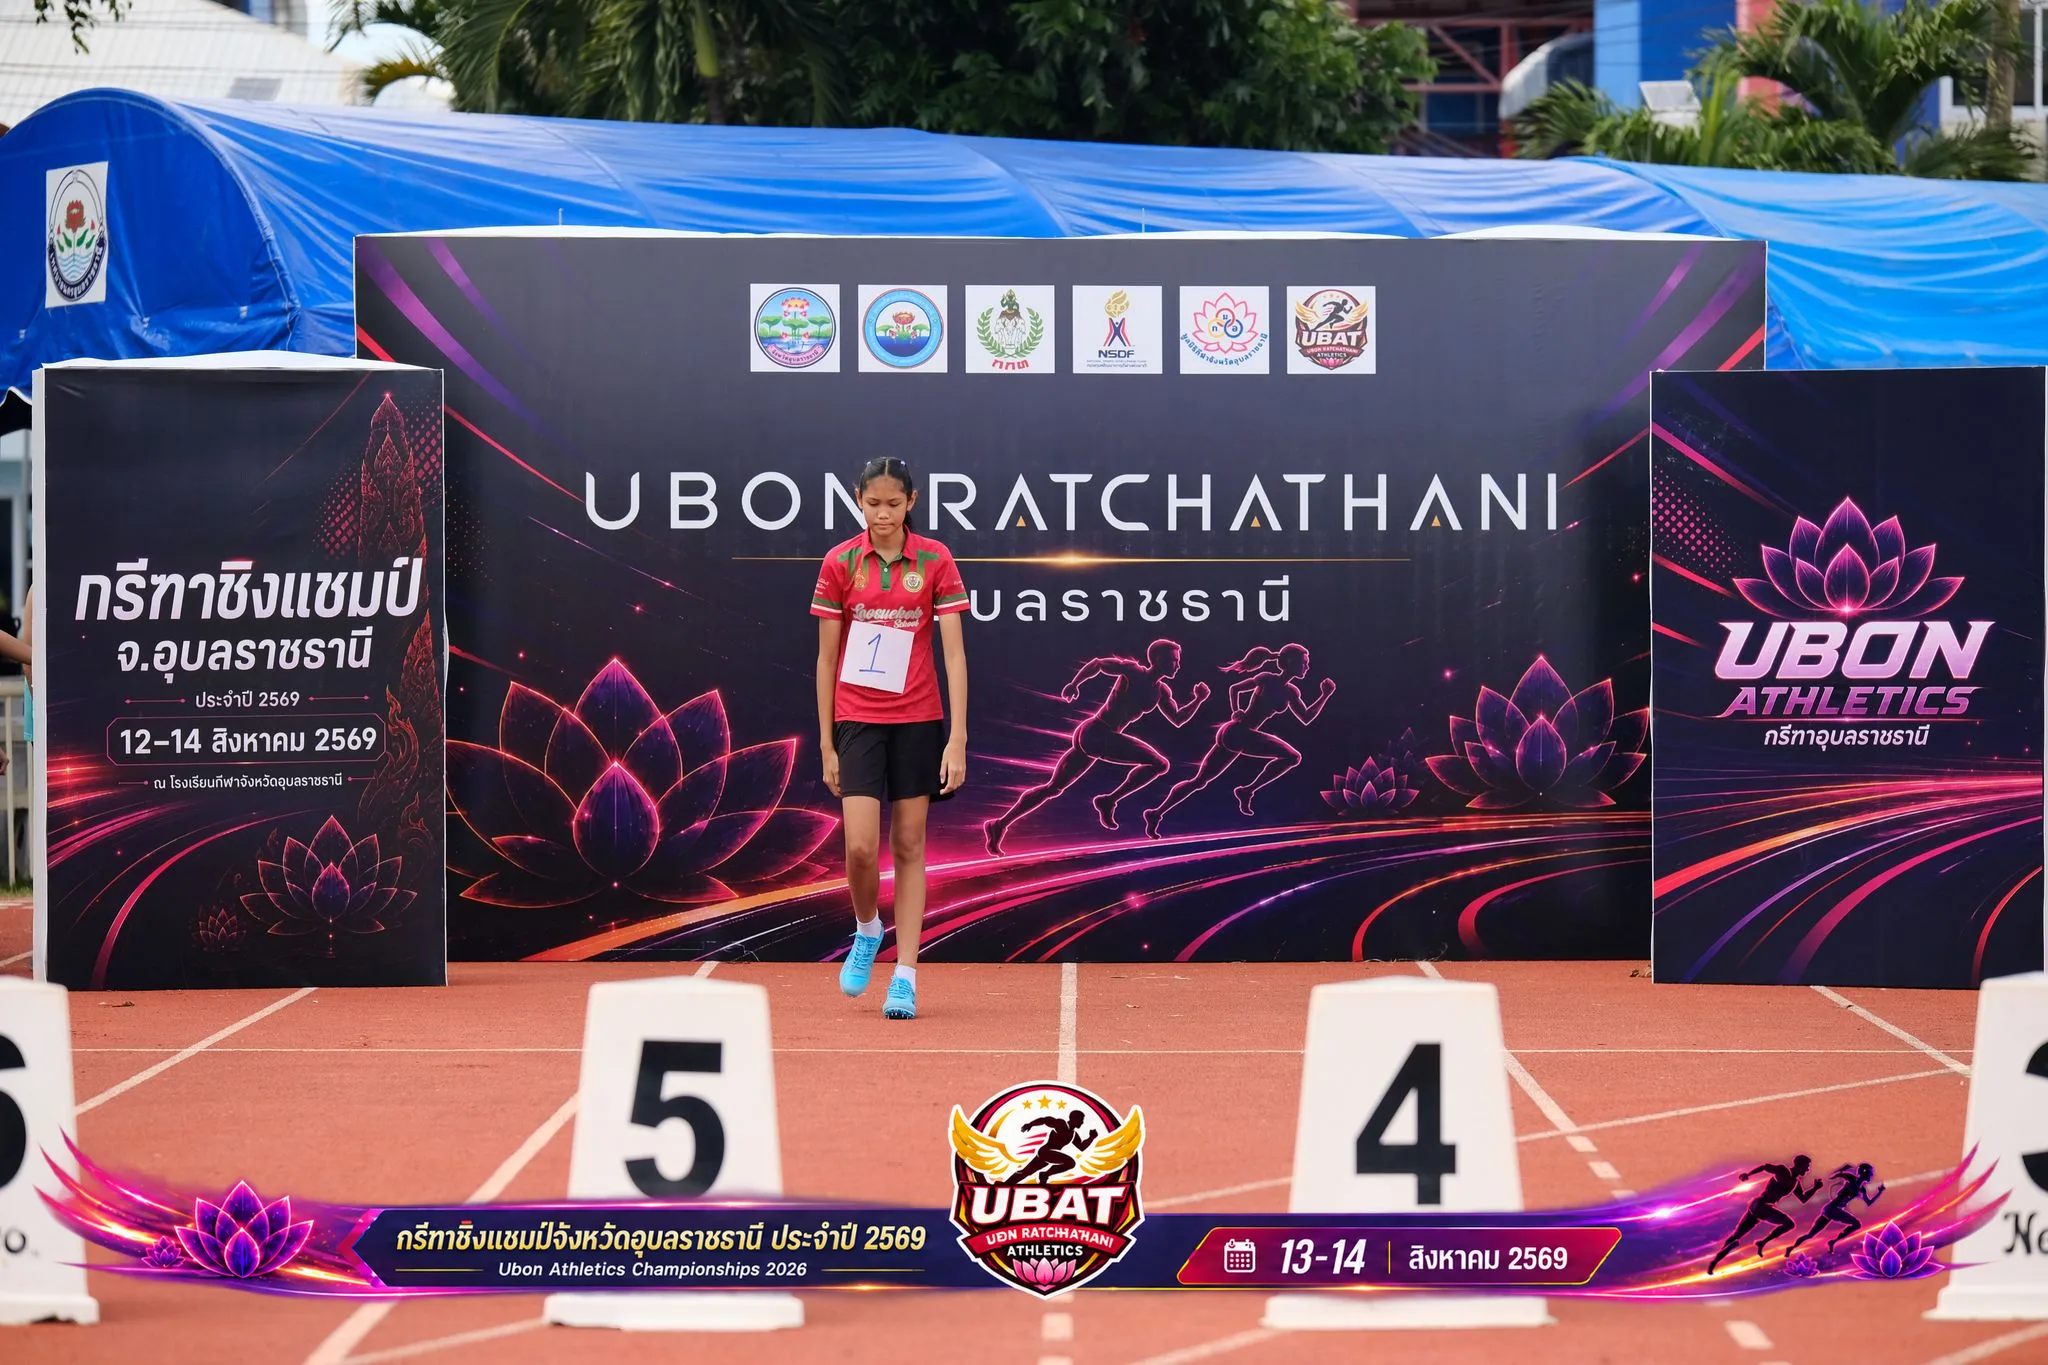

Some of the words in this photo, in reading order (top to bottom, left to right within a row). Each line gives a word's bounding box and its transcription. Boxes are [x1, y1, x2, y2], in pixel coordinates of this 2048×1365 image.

[1098, 349, 1135, 358] NSDF
[1301, 331, 1362, 347] UBAT
[586, 472, 867, 530] UBON
[929, 473, 1557, 531] RATCHATHANI
[75, 557, 423, 620] กรีฑาชิงแชมป์
[933, 575, 1290, 622] บลราชธานี
[859, 633, 886, 674] 1
[1714, 621, 1996, 679] UBON
[195, 690, 252, 708] ประจำปี
[258, 691, 300, 707] 2569
[1724, 686, 1983, 716] ATHLETICS
[120, 728, 202, 754] 12-14
[212, 727, 305, 753] สิงหาคม
[314, 727, 377, 752] 2569
[154, 779, 166, 789] ณ
[625, 1040, 725, 1199] 5
[1356, 1043, 1456, 1205] 4
